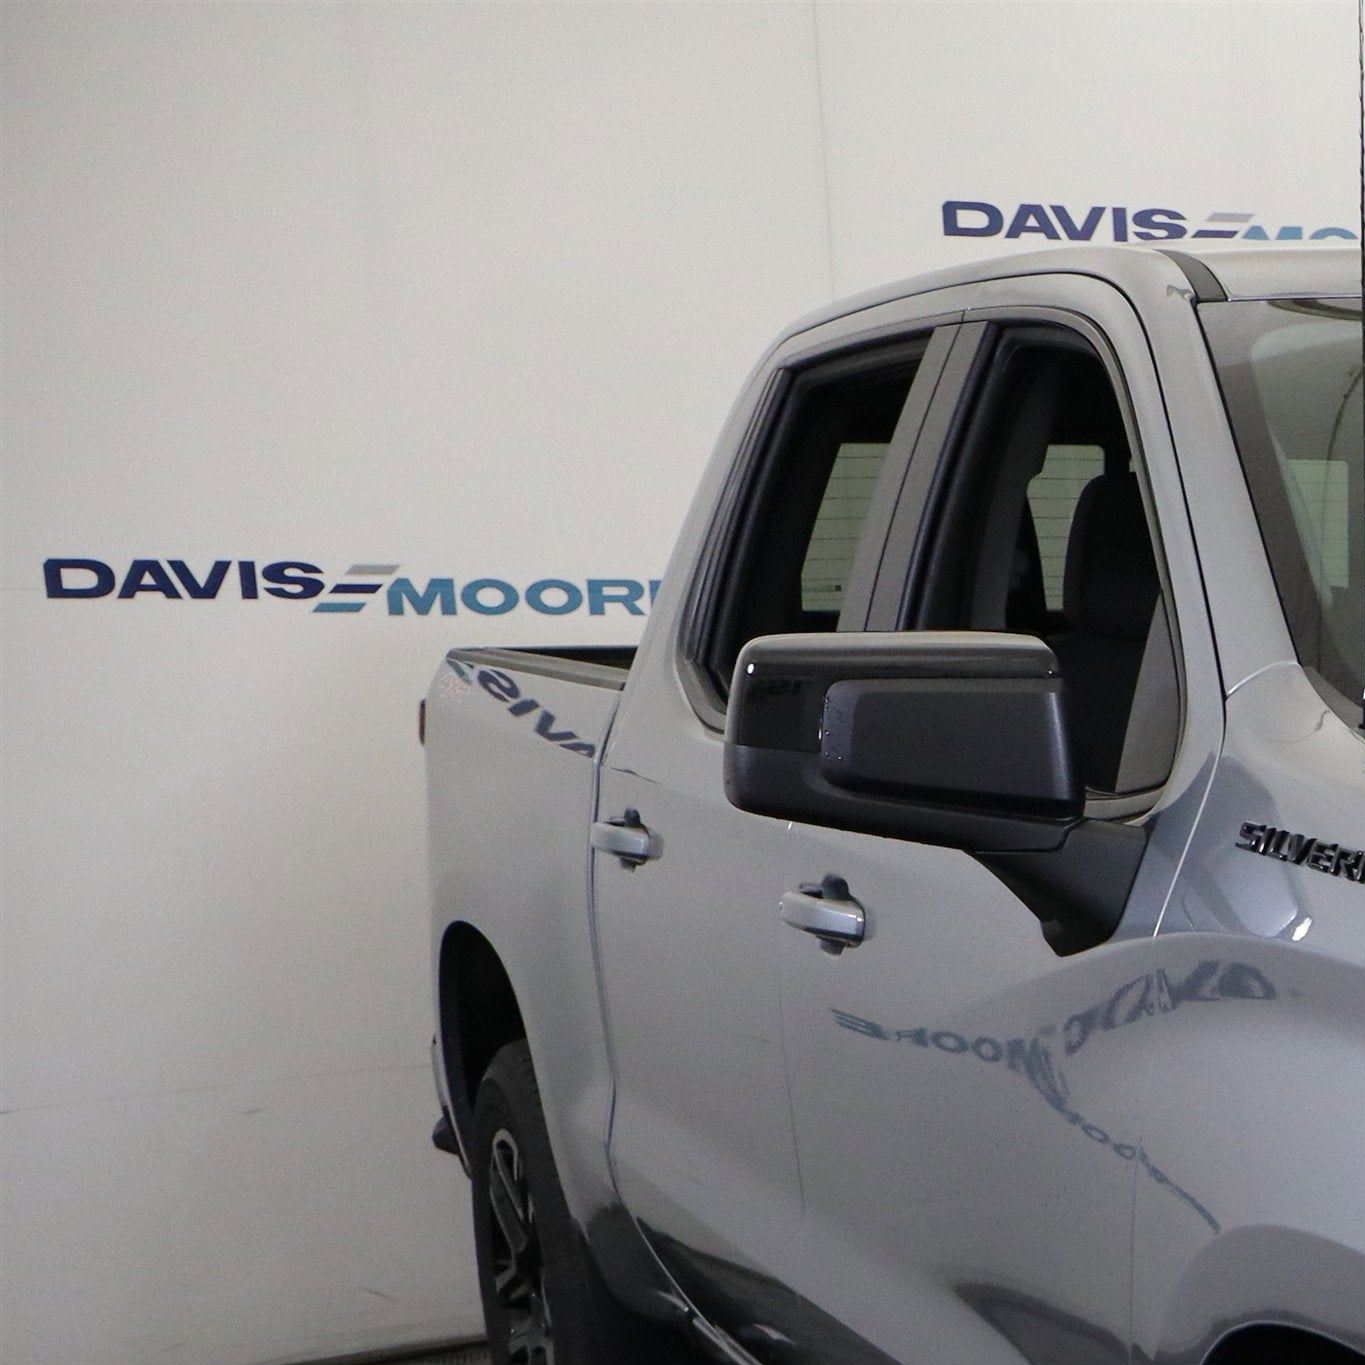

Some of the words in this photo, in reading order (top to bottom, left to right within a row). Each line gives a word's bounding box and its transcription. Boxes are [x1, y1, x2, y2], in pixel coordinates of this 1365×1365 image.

[942, 199, 1186, 241] DAVIS
[42, 556, 325, 599] DAVIS
[386, 576, 661, 616] MOOR
